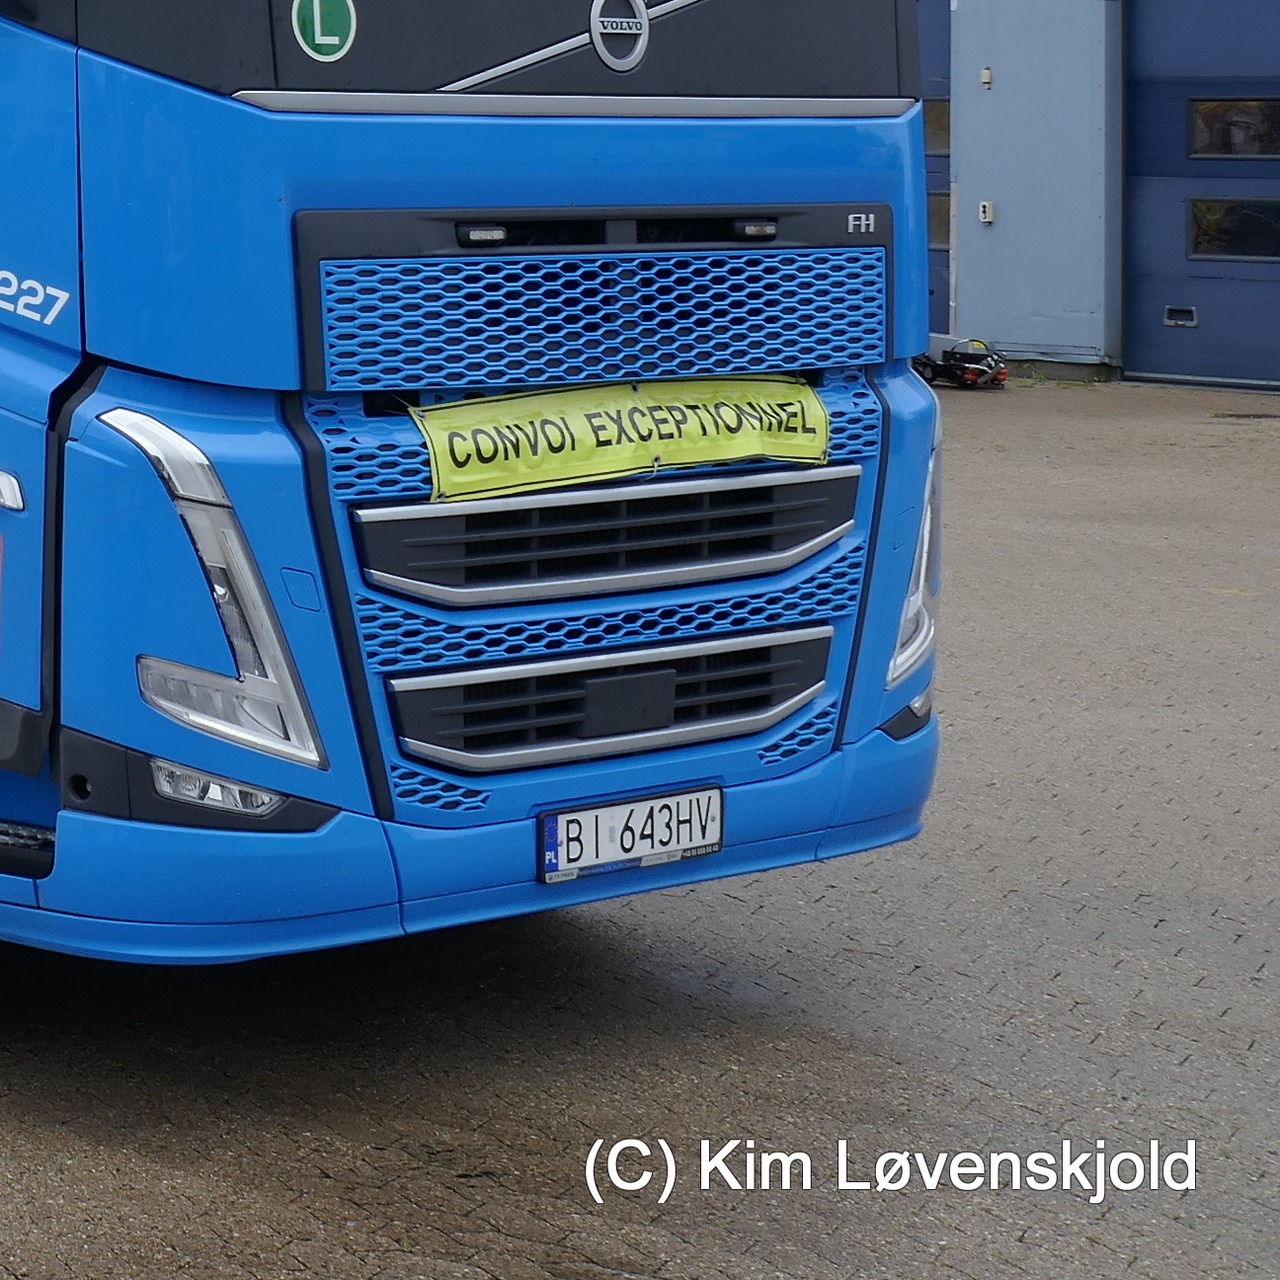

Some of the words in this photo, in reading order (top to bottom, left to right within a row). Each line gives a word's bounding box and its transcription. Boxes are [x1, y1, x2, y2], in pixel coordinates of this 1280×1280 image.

[599, 20, 643, 32] VOLVO
[847, 213, 875, 233] FH
[447, 415, 578, 470] CONVOI
[591, 398, 819, 450] EXCEPTIONNEL
[566, 815, 599, 863] BI
[620, 796, 712, 853] 643HV
[545, 851, 557, 864] PL
